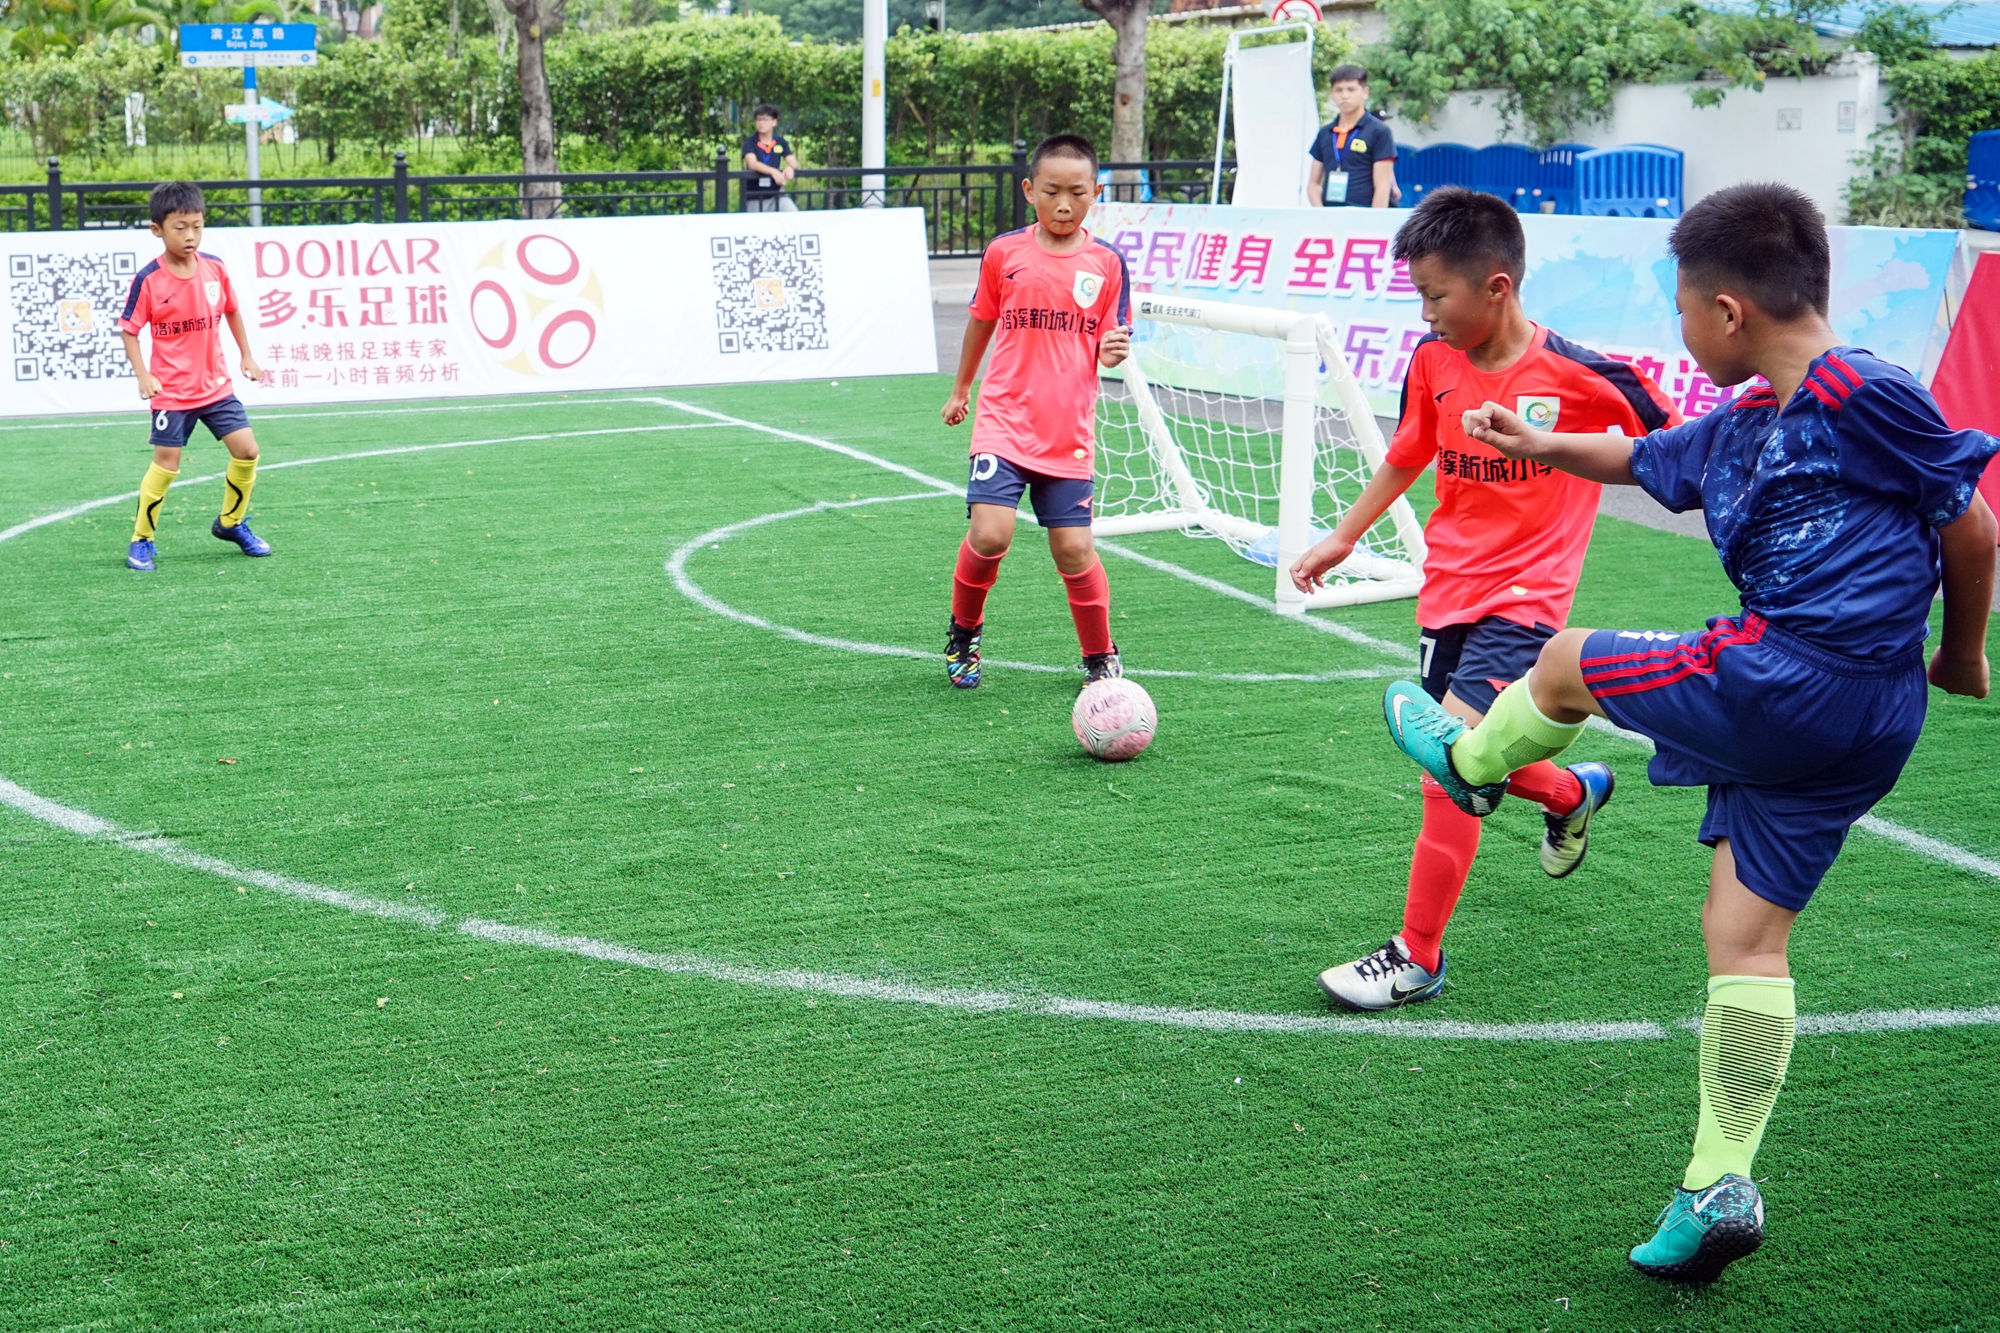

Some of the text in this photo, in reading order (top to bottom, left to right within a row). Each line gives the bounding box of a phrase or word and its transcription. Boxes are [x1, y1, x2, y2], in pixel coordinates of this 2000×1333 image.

[210, 27, 285, 40] 滨江东路
[1111, 230, 1274, 285] 全民健身
[258, 285, 449, 329] 多乐足球
[267, 338, 448, 363] 羊城晚报足球专家
[258, 362, 460, 389] 赛前一小时音频分析
[155, 409, 169, 431] 6
